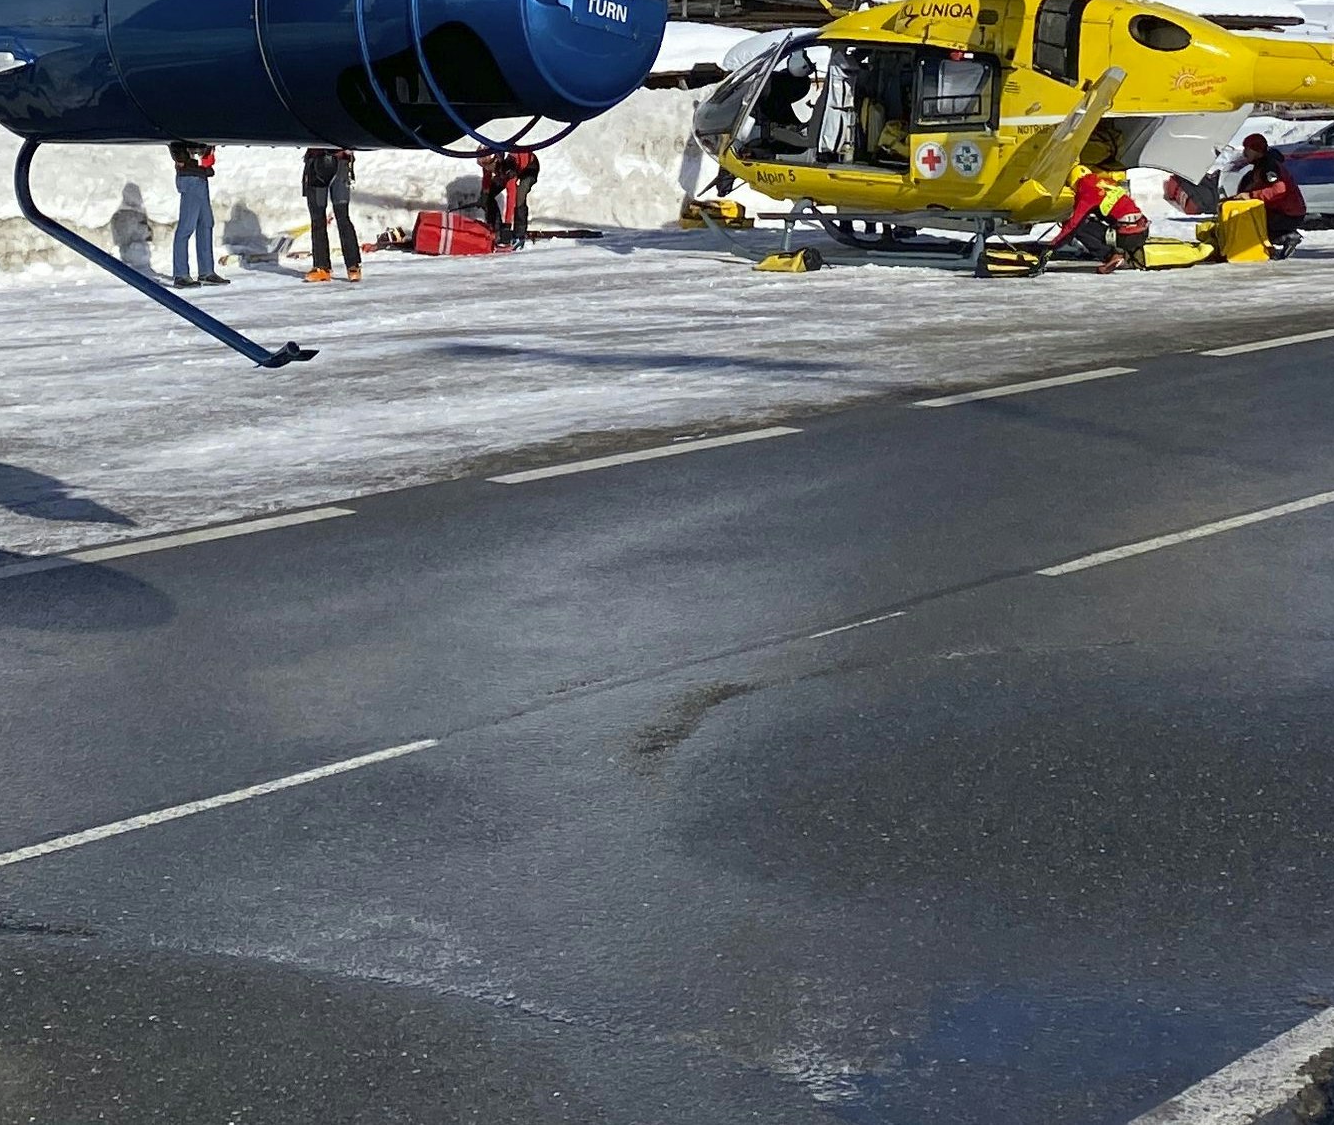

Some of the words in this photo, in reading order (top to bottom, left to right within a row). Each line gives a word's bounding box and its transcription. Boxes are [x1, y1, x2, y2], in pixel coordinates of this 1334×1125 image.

[920, 3, 973, 18] UNIQA
[756, 169, 786, 186] Alpin
[788, 169, 796, 182] 5
